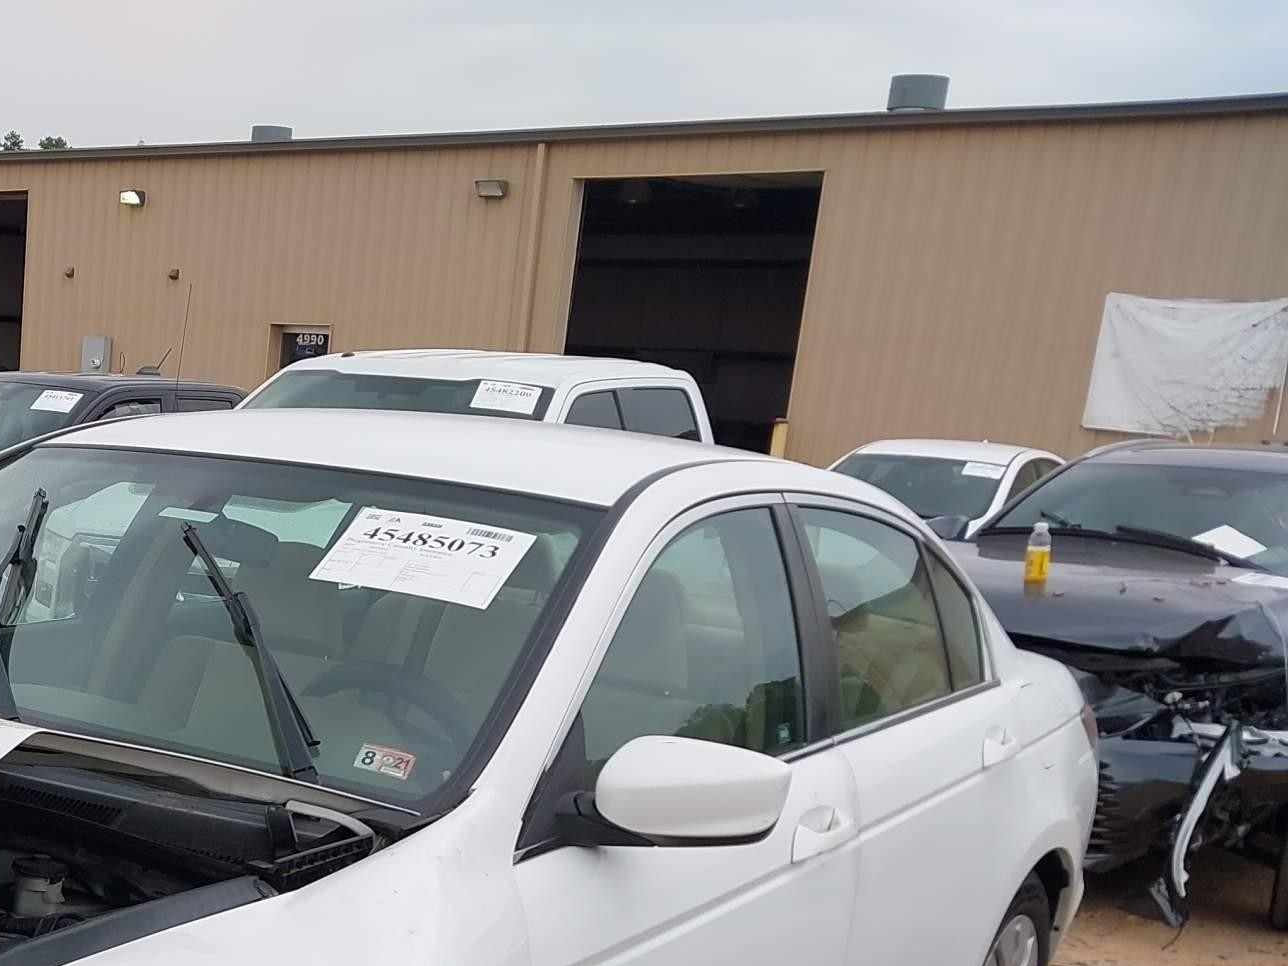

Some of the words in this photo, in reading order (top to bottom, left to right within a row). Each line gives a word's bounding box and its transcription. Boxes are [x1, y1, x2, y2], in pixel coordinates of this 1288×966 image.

[296, 334, 325, 345] 4990
[362, 526, 501, 559] 45485073
[361, 750, 377, 766] 8
